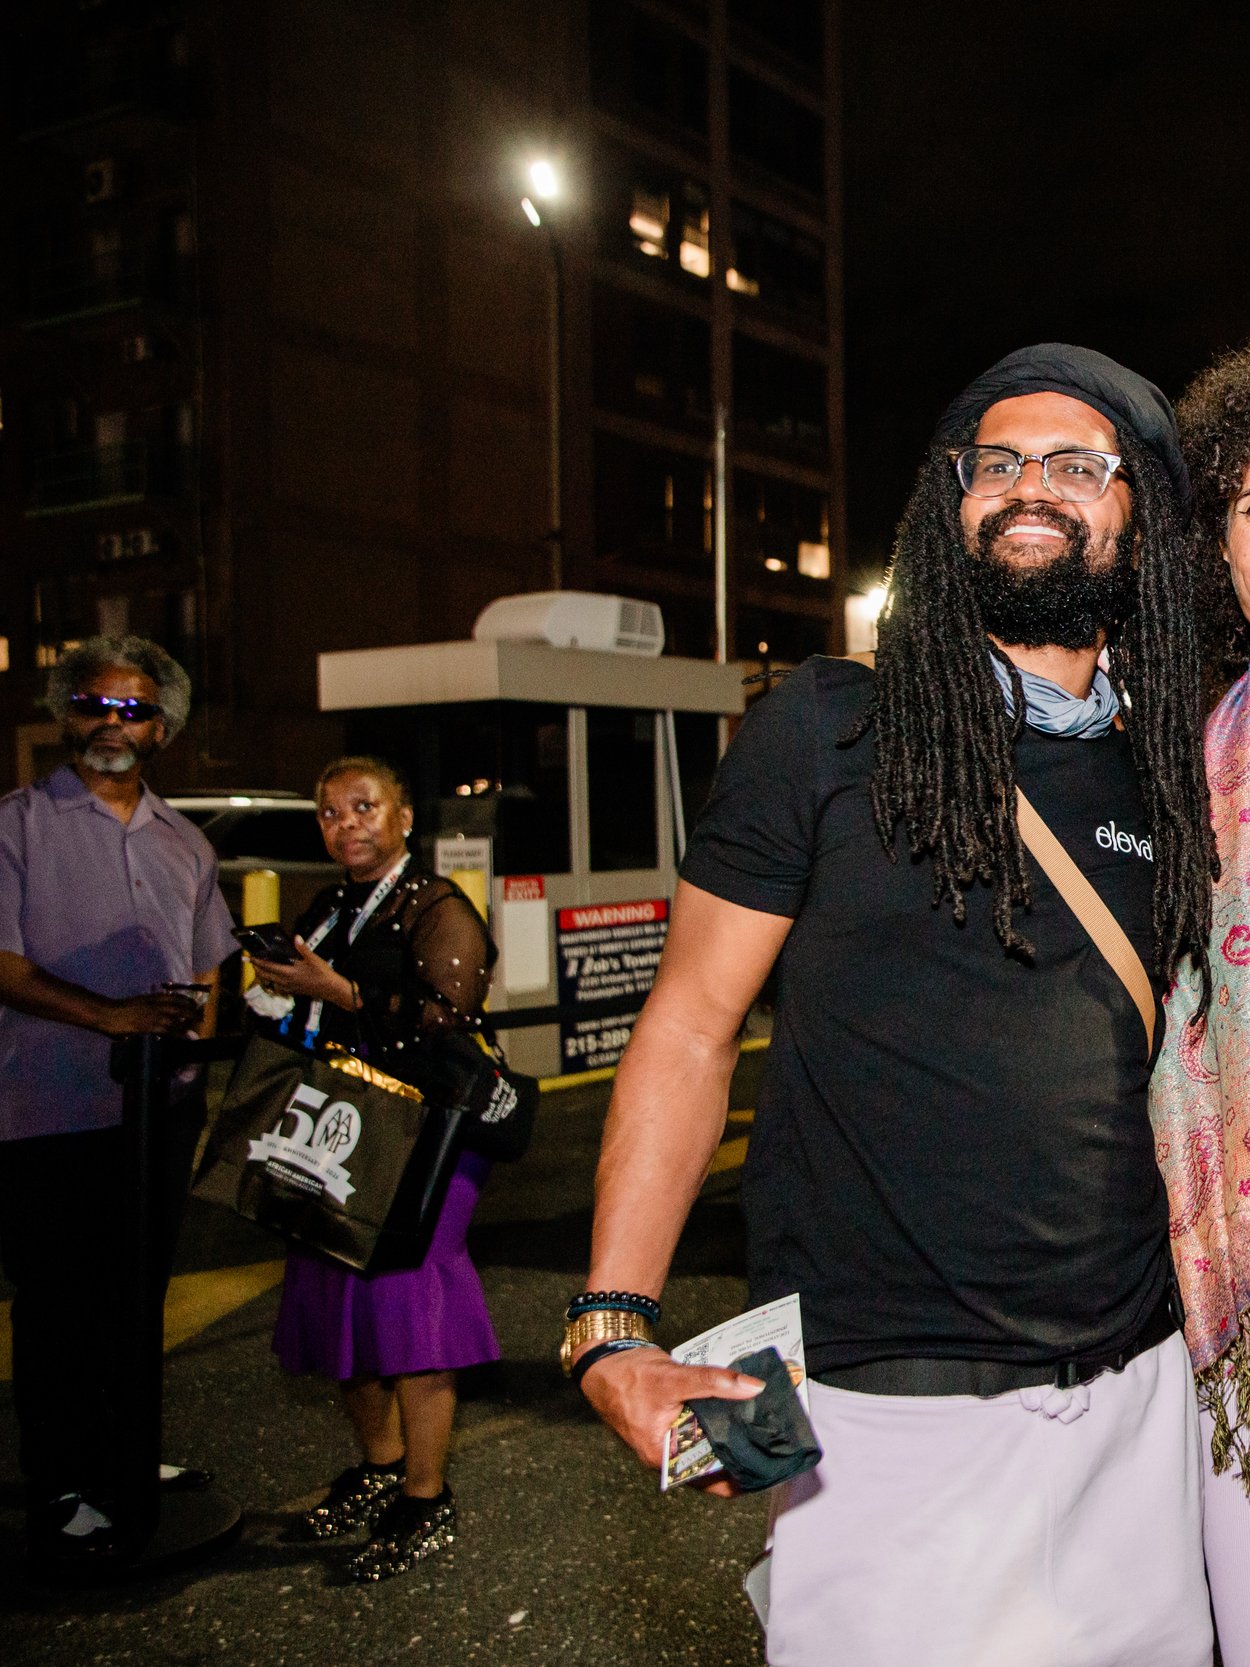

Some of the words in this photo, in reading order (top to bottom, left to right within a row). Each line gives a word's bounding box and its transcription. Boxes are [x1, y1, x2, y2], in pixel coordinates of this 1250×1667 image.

[1095, 820, 1153, 862] eleva
[572, 903, 656, 928] WARNING
[622, 952, 661, 969] Towin
